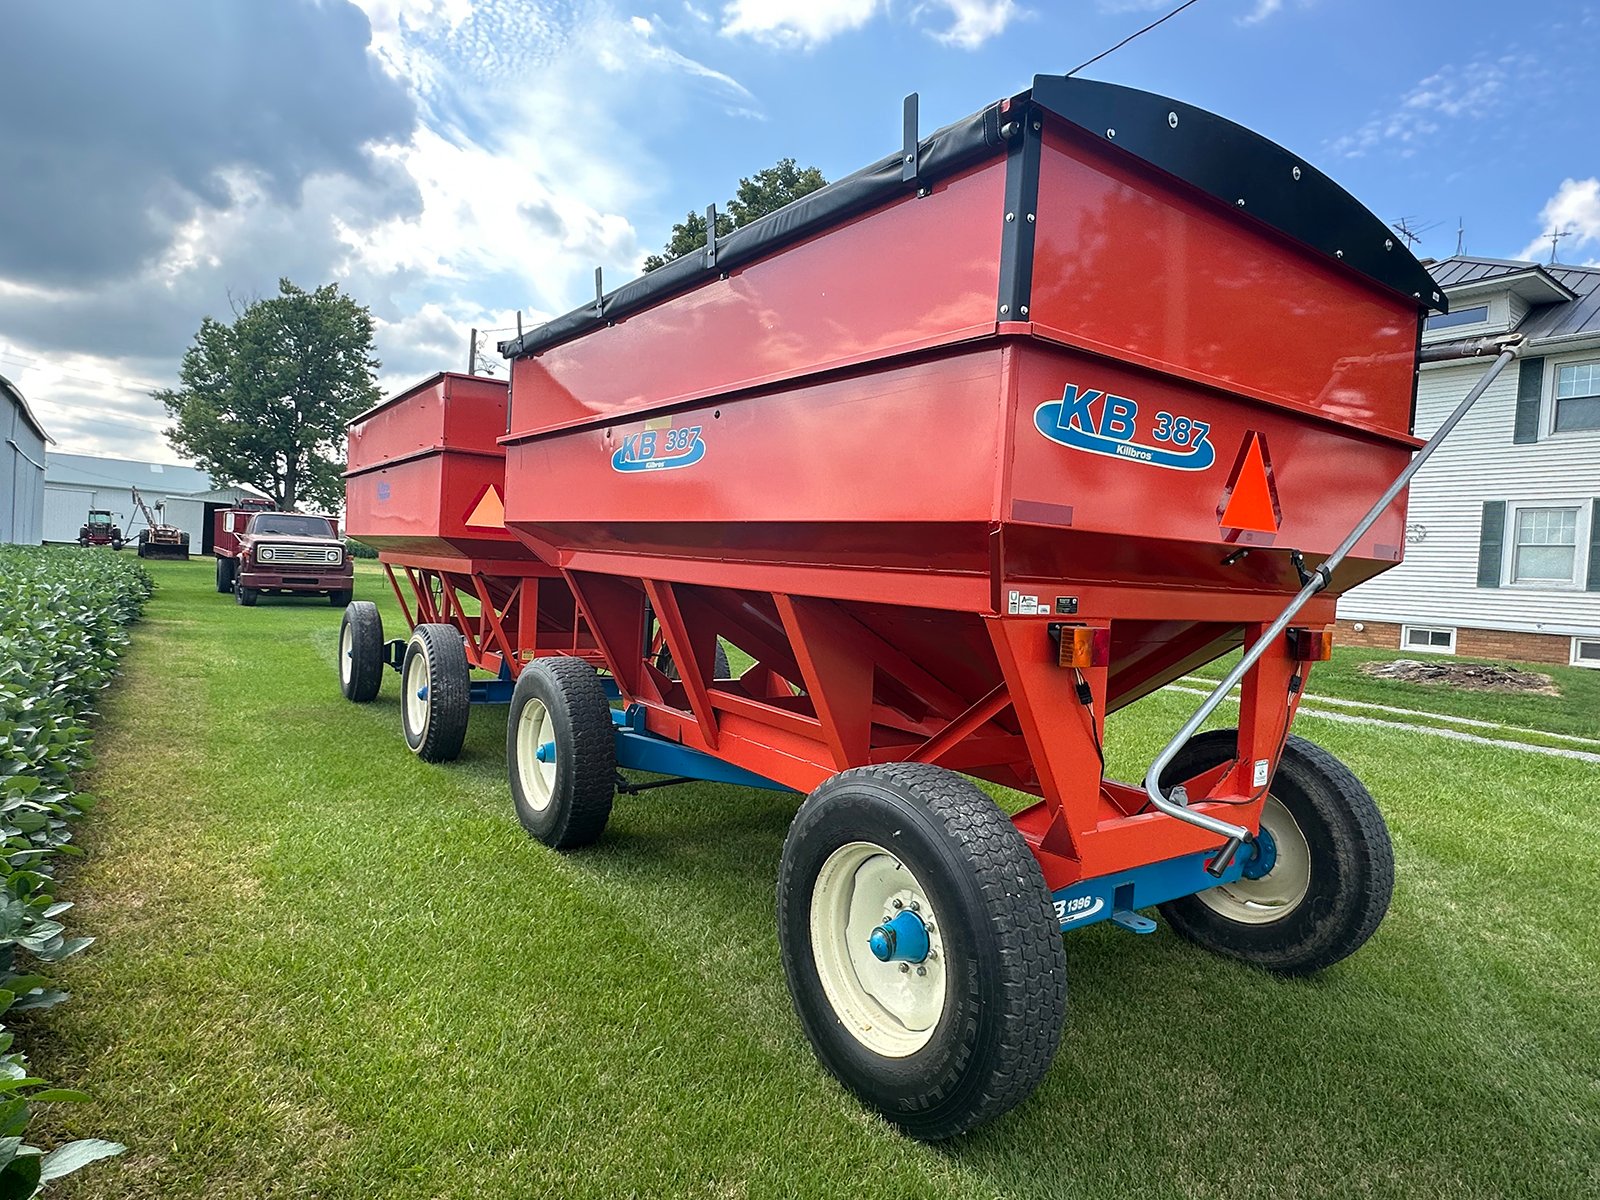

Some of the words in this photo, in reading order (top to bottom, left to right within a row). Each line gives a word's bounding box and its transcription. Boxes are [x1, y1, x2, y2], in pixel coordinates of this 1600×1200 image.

[1057, 383, 1138, 442] KB
[1152, 411, 1211, 450] 387
[619, 431, 658, 464] KB
[665, 425, 703, 452] 387
[1067, 895, 1092, 913] 1396
[899, 958, 980, 1112] MICHELIN
